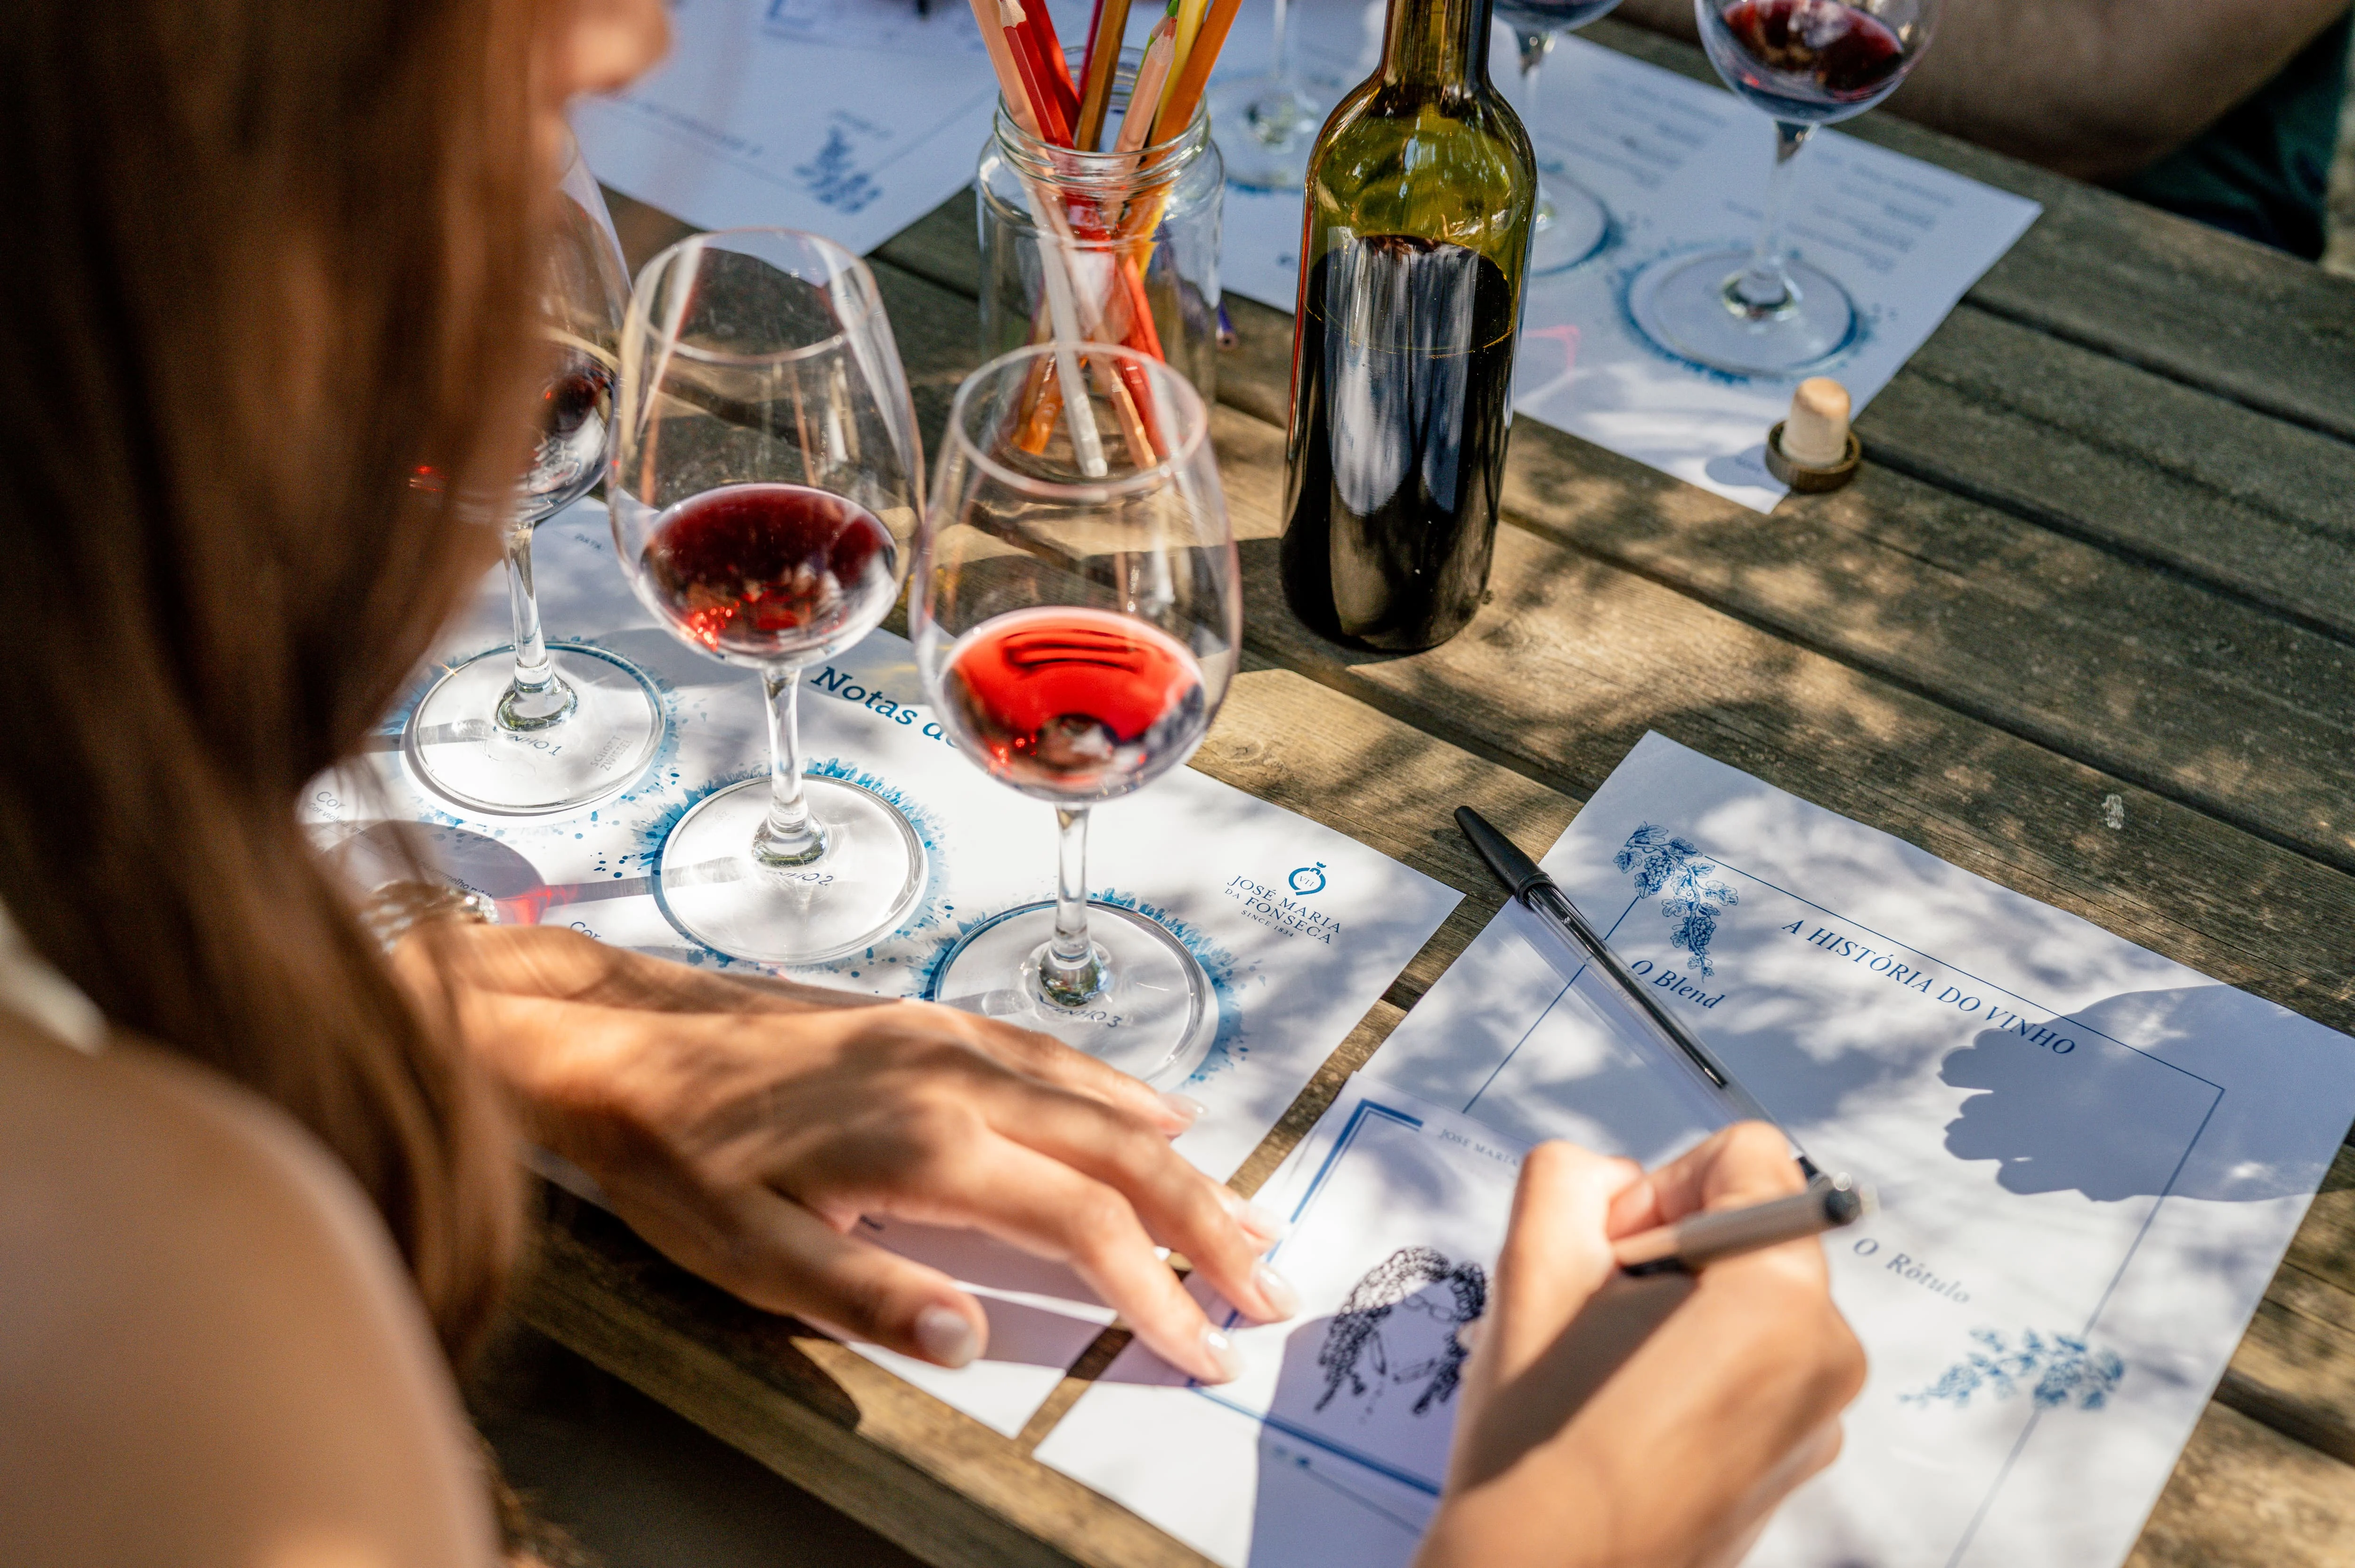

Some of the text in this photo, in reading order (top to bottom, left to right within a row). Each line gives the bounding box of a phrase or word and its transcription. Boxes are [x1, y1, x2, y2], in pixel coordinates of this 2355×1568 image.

[810, 666, 918, 725] Notas
[548, 746, 562, 756] 1
[309, 802, 323, 813] Cor
[317, 792, 345, 809] Cor
[1299, 876, 1314, 887] VII
[1225, 889, 1331, 944] DA FONSECA
[1227, 875, 1340, 934] JOSÉ MARIA
[1241, 910, 1294, 938] SINCE 1834
[1631, 960, 1653, 975] O
[1652, 970, 1726, 1009] Blend
[1781, 920, 2075, 1053] A HISTÓRIA DO VINHO
[1107, 1016, 1122, 1027] 3
[1853, 1238, 1971, 1303] O Rótulo
